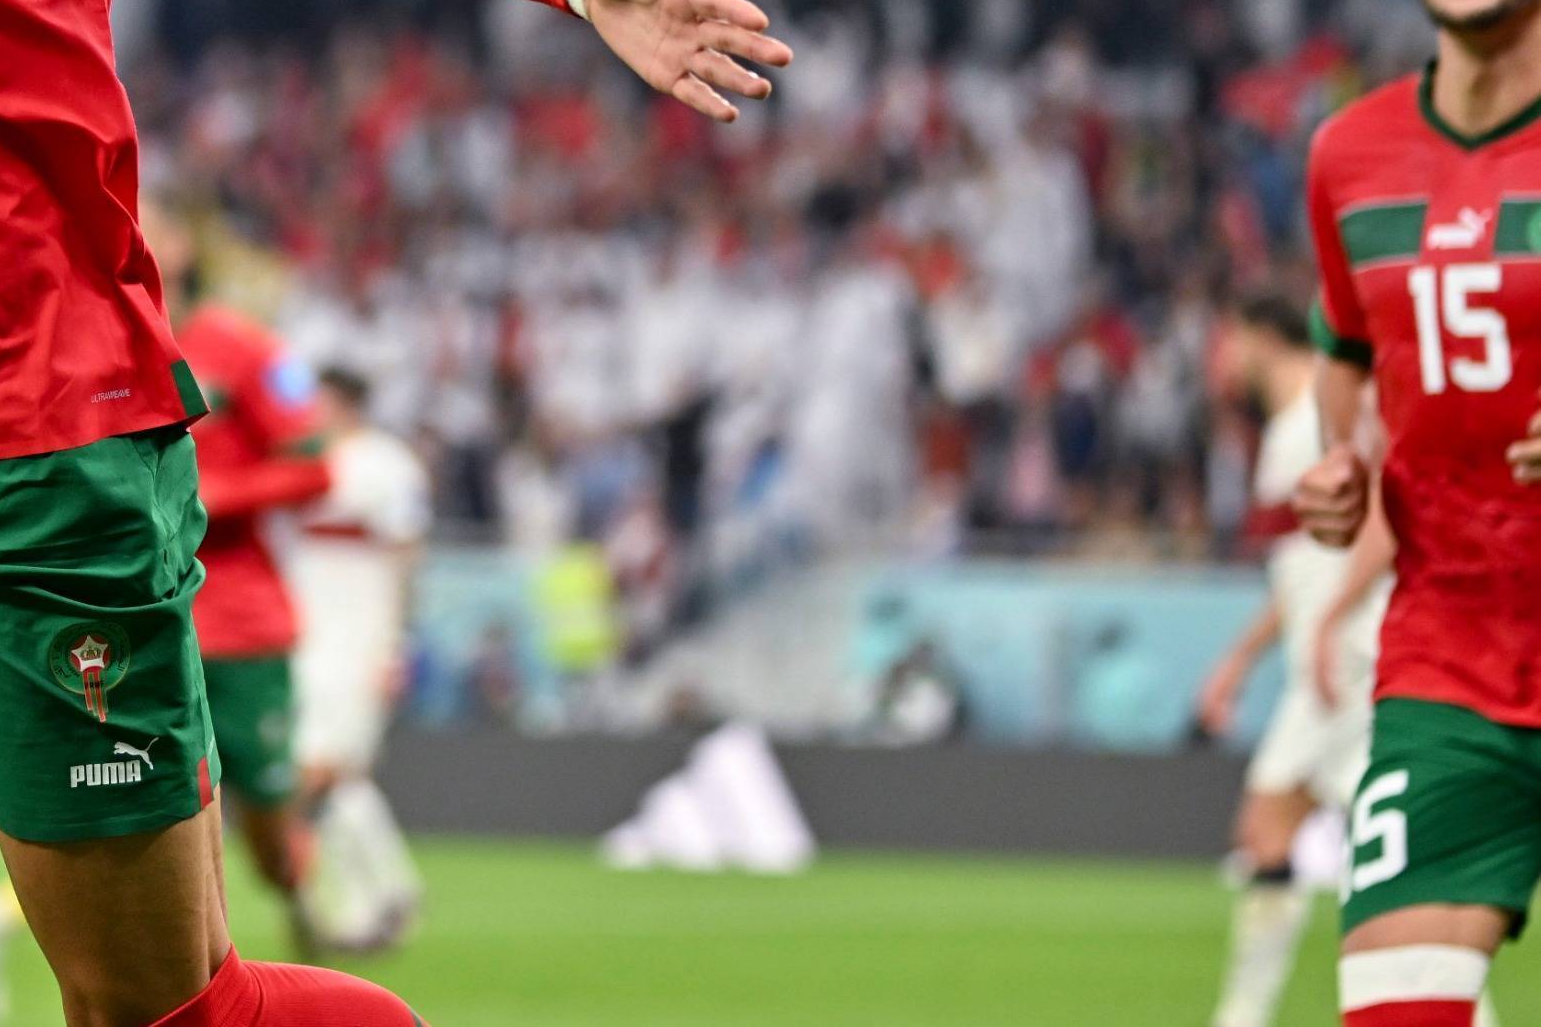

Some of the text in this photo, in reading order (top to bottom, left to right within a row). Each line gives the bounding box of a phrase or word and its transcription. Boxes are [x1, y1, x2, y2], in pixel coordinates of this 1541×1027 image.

[1407, 262, 1513, 396] 15
[70, 759, 143, 788] PUMA
[1339, 769, 1410, 906] 5
